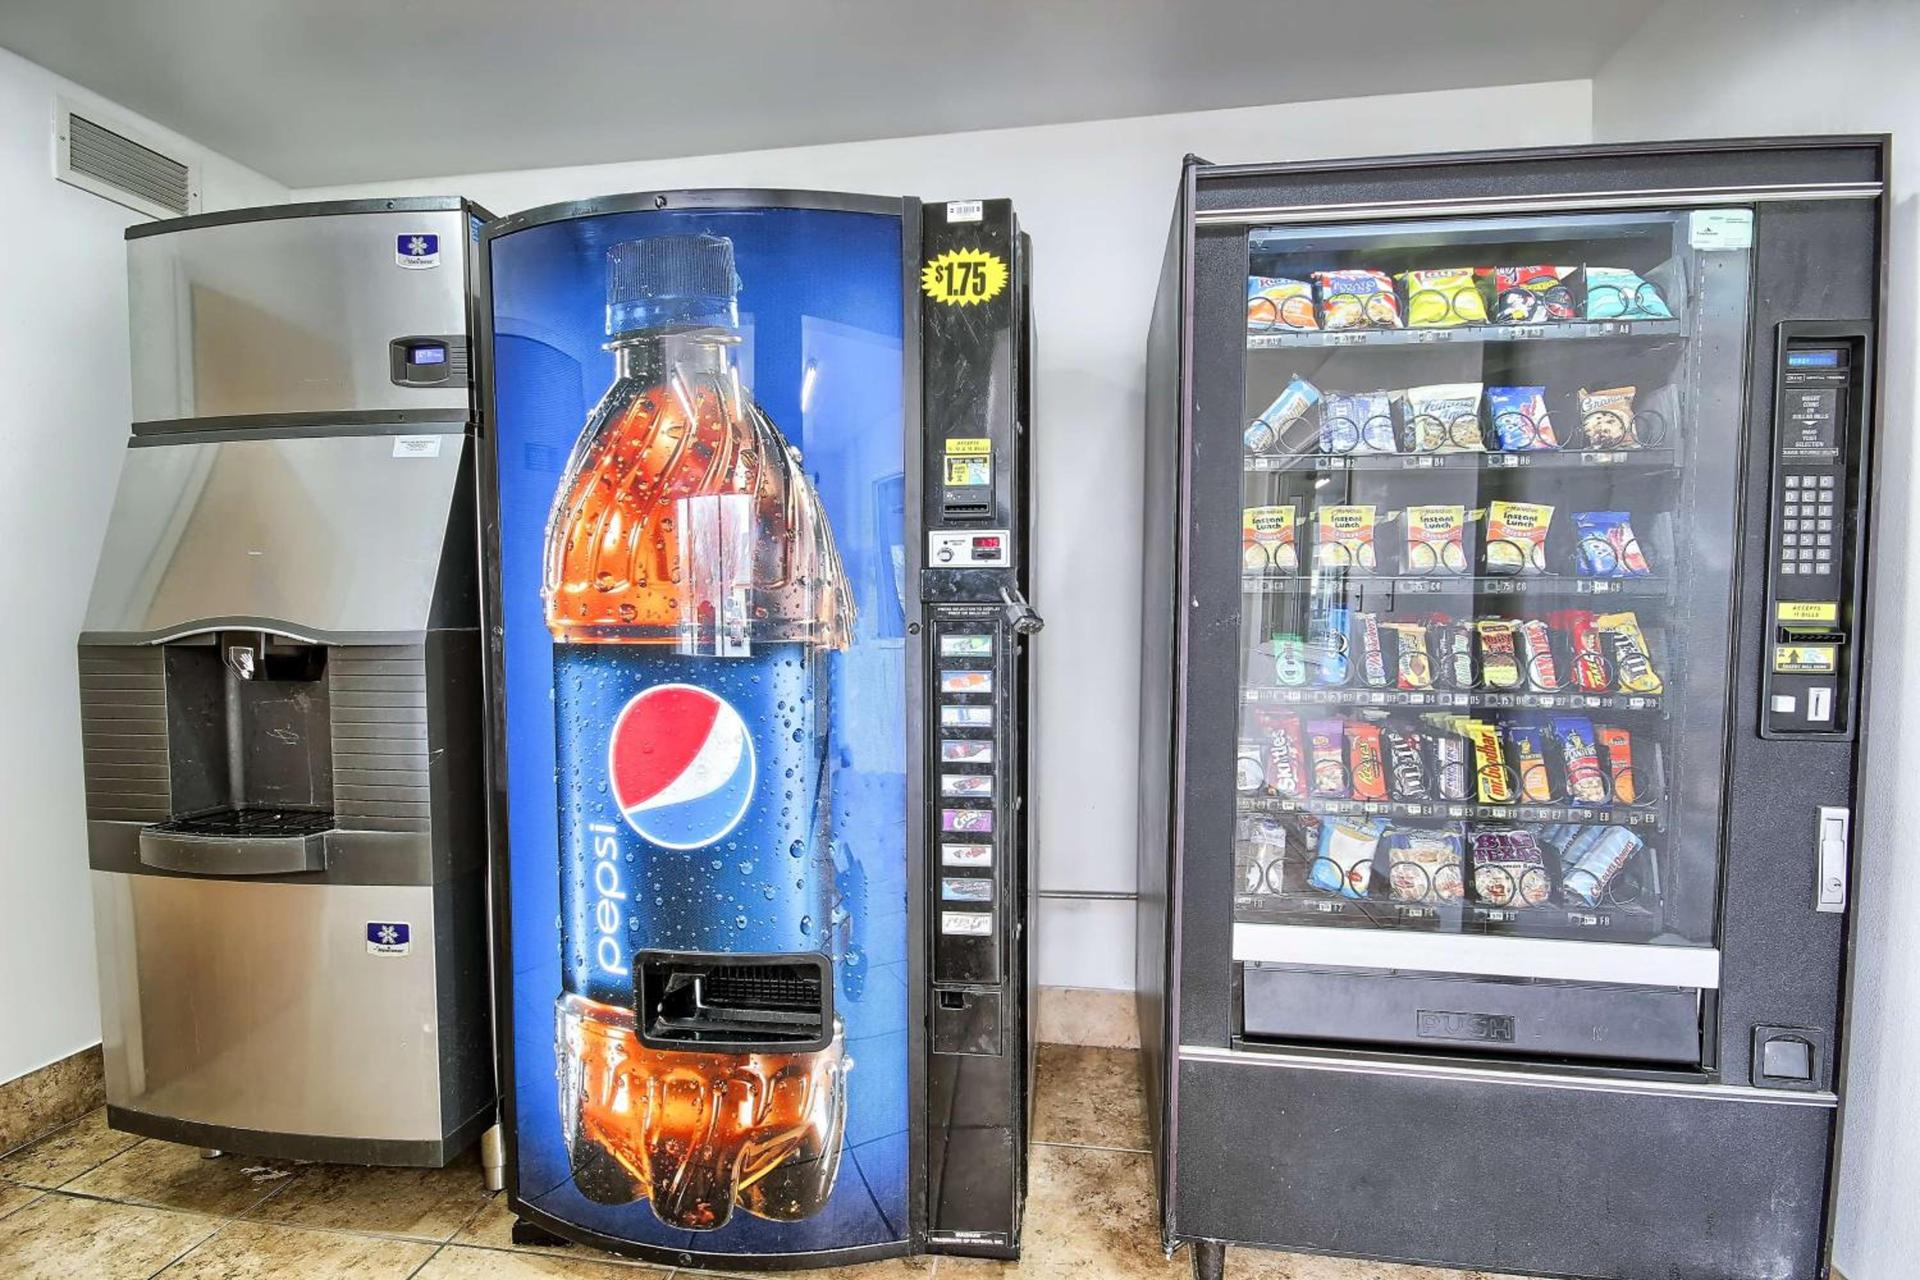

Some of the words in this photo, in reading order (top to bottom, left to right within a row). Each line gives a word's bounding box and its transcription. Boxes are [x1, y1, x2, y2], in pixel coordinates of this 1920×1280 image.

[935, 261, 987, 297] $1.75
[1252, 516, 1284, 524] Instant
[1504, 512, 1538, 522] Instant
[1256, 522, 1282, 530] Lunch
[1335, 520, 1360, 528] Lunch
[1424, 521, 1451, 529] Lunch
[1506, 519, 1534, 528] Lunch
[1270, 729, 1298, 792] Skittles
[1476, 848, 1541, 863] TEXAS
[590, 823, 628, 976] pepsi
[1422, 1014, 1511, 1039] PUSH
